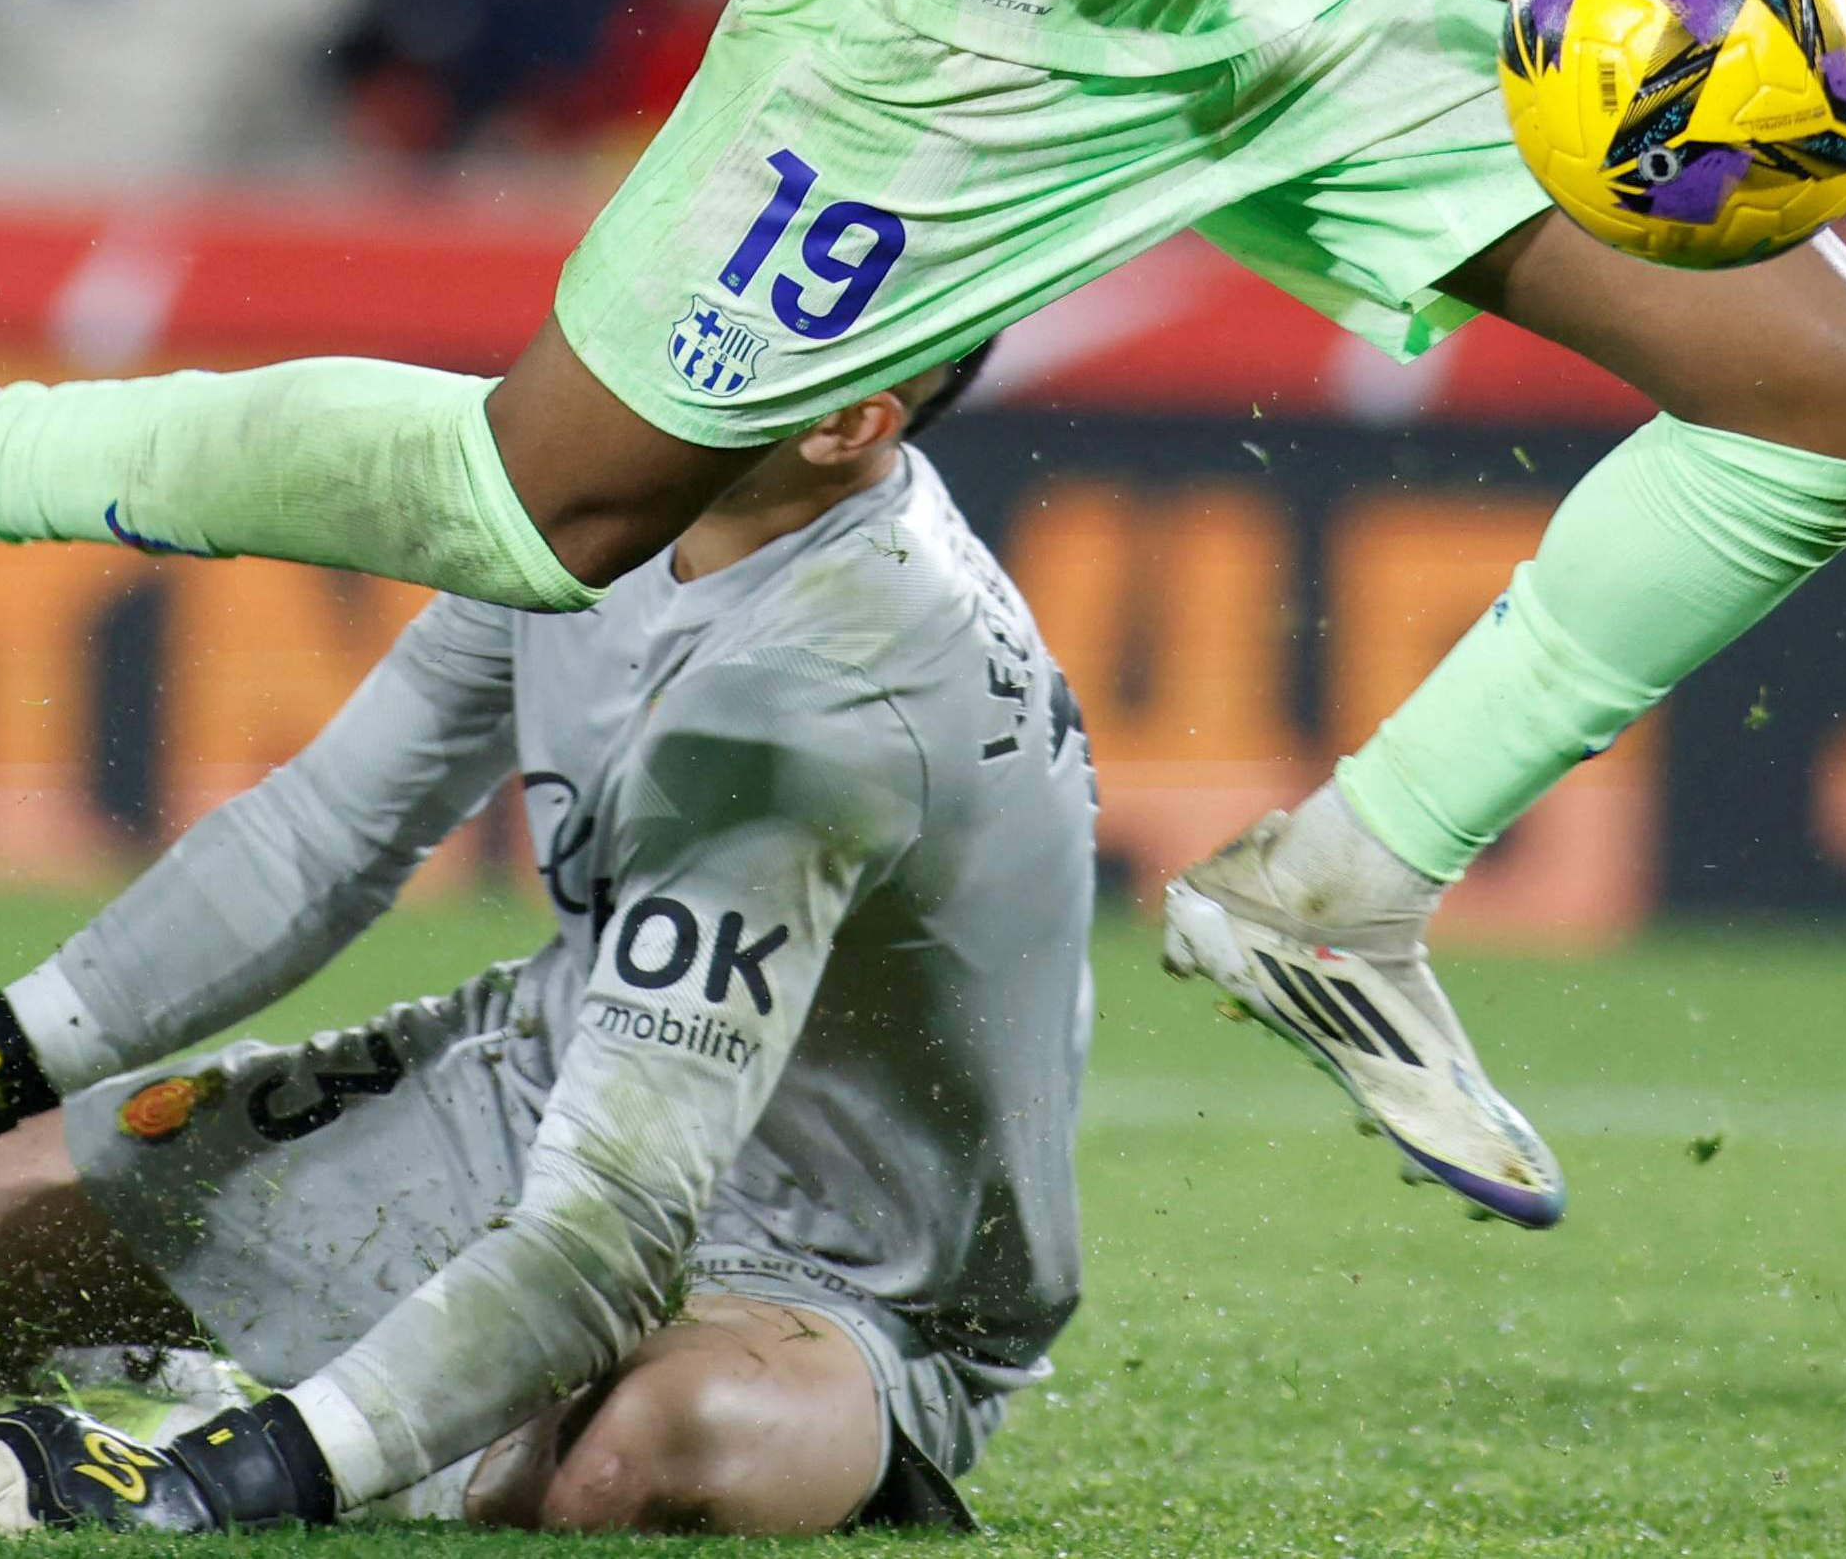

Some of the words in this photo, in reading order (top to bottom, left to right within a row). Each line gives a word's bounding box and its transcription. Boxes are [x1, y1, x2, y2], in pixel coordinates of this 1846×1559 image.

[718, 148, 906, 340] 19
[616, 896, 790, 1016] OK
[594, 1005, 761, 1074] mobility
